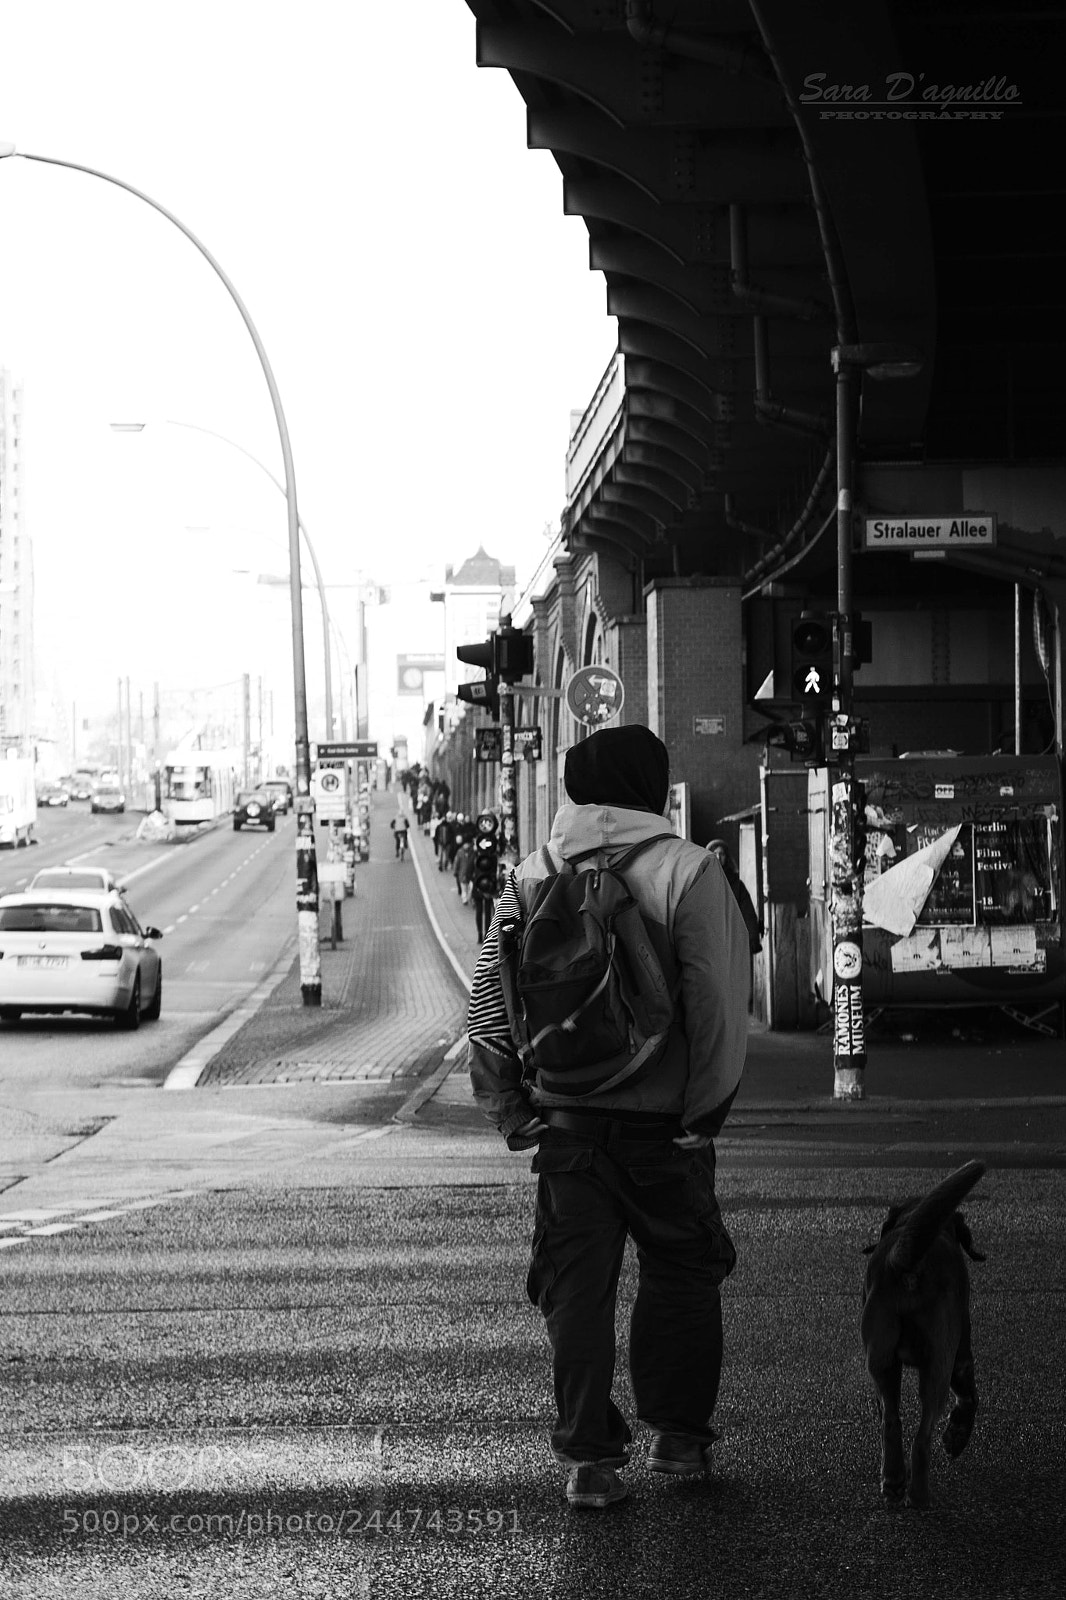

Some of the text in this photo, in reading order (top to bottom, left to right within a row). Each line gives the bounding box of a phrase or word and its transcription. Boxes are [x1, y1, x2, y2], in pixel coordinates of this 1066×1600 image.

[873, 520, 987, 539] Stralauer Allee
[976, 822, 1007, 832] Berlin
[976, 848, 1001, 858] Film
[837, 984, 851, 1056] RAMONES
[851, 985, 865, 1055] MUSEUM
